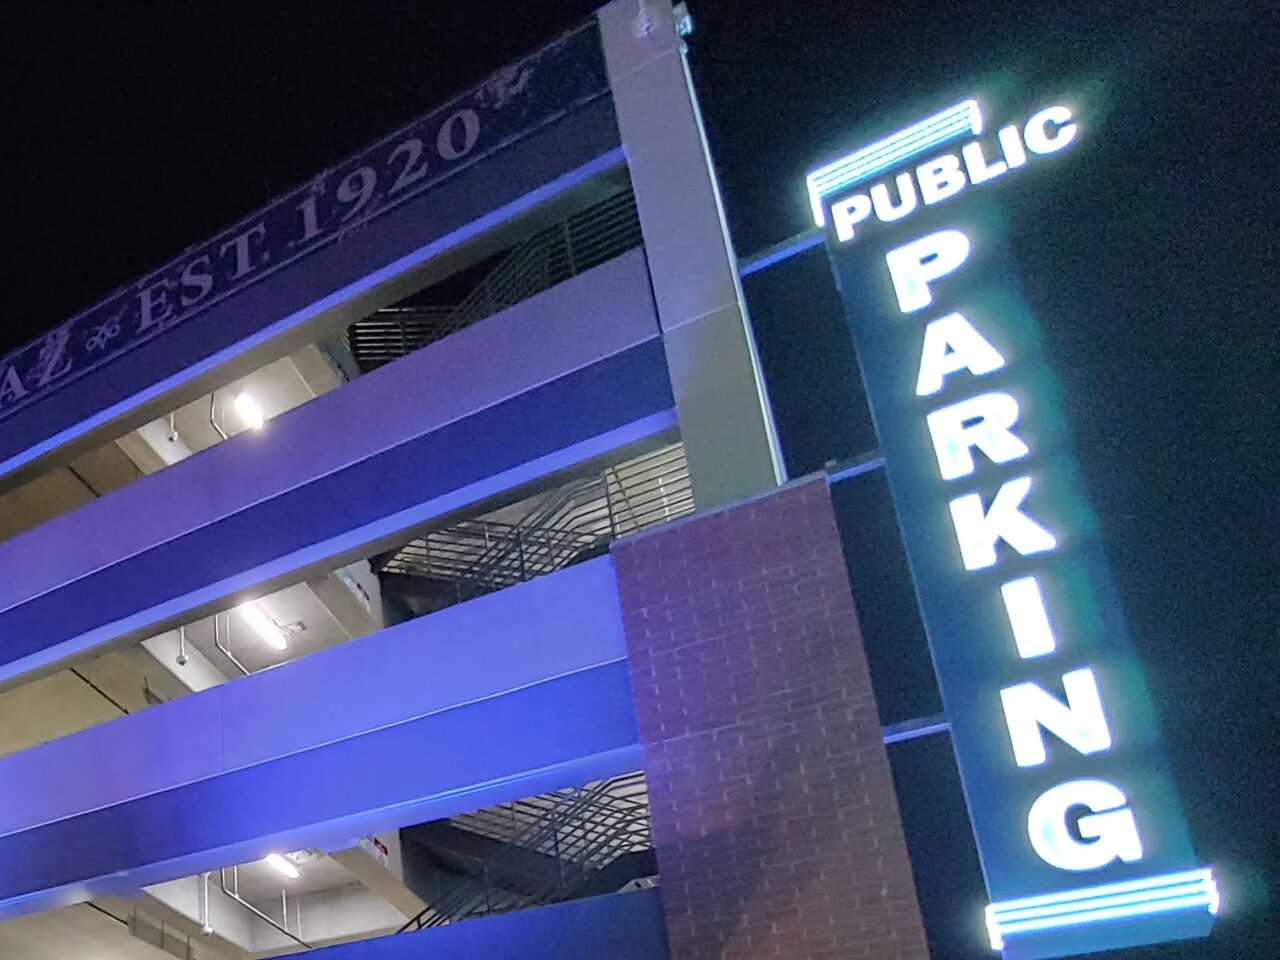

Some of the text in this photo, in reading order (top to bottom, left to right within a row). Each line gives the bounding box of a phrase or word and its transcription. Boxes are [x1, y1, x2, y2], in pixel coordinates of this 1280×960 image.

[135, 223, 270, 336] EST.
[288, 109, 481, 243] 1920
[830, 105, 1078, 243] PUBLIC
[886, 229, 1144, 871] PARKING
